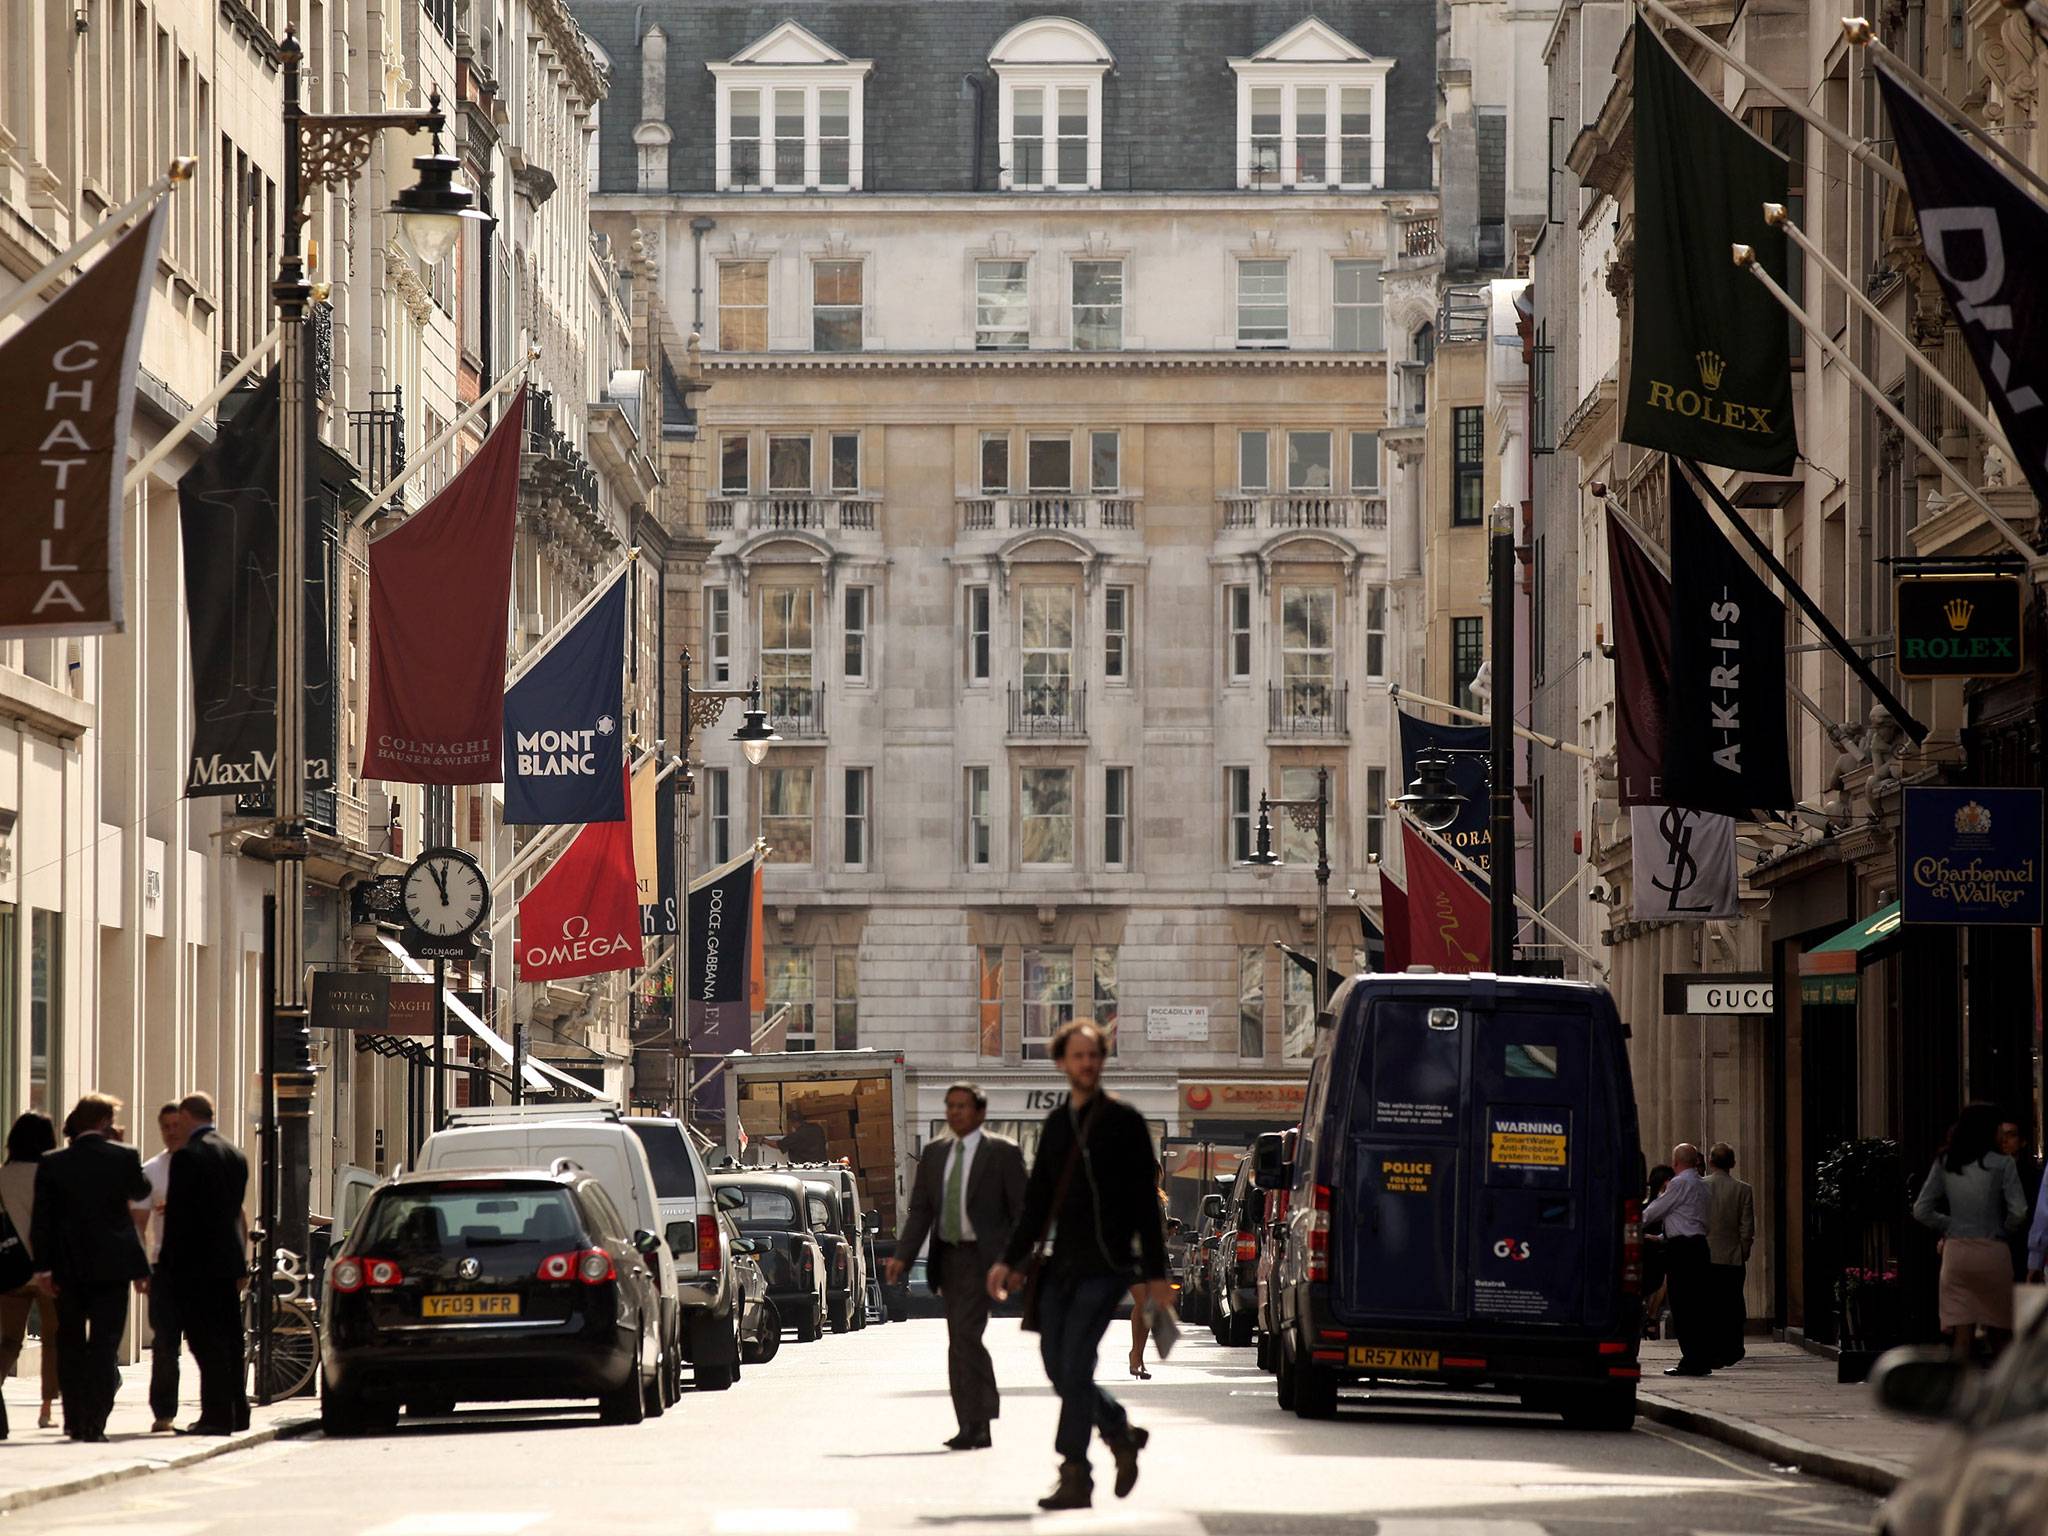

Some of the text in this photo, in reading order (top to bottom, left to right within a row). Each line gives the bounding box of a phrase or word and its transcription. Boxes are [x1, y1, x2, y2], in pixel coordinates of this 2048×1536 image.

[1646, 379, 1775, 434] ROLEX
[32, 340, 99, 614] CHATILA
[1904, 638, 2015, 658] ROLEX
[378, 735, 489, 755] COLNAGHI
[517, 730, 595, 753] MONT
[189, 750, 329, 787] MaxMra
[518, 753, 595, 776] BLANC
[1913, 856, 2033, 887] Charbonnel
[1932, 881, 2025, 909] et Walker
[708, 889, 723, 929] DOLCE
[421, 948, 463, 956] COLNAGHI
[526, 933, 632, 967] OMEGA
[702, 937, 720, 1000] GABBANA
[1026, 1090, 1071, 1109] itsu
[1495, 1121, 1563, 1134] WARNING
[1500, 1144, 1559, 1154] Anti-Robbery
[1382, 1162, 1432, 1175] POLICE
[1386, 1183, 1427, 1192] THIS VAN
[1390, 1176, 1424, 1184] FOLLOW
[430, 1297, 511, 1313] YF09 WFR
[1354, 1348, 1433, 1367] LR57 KNY
